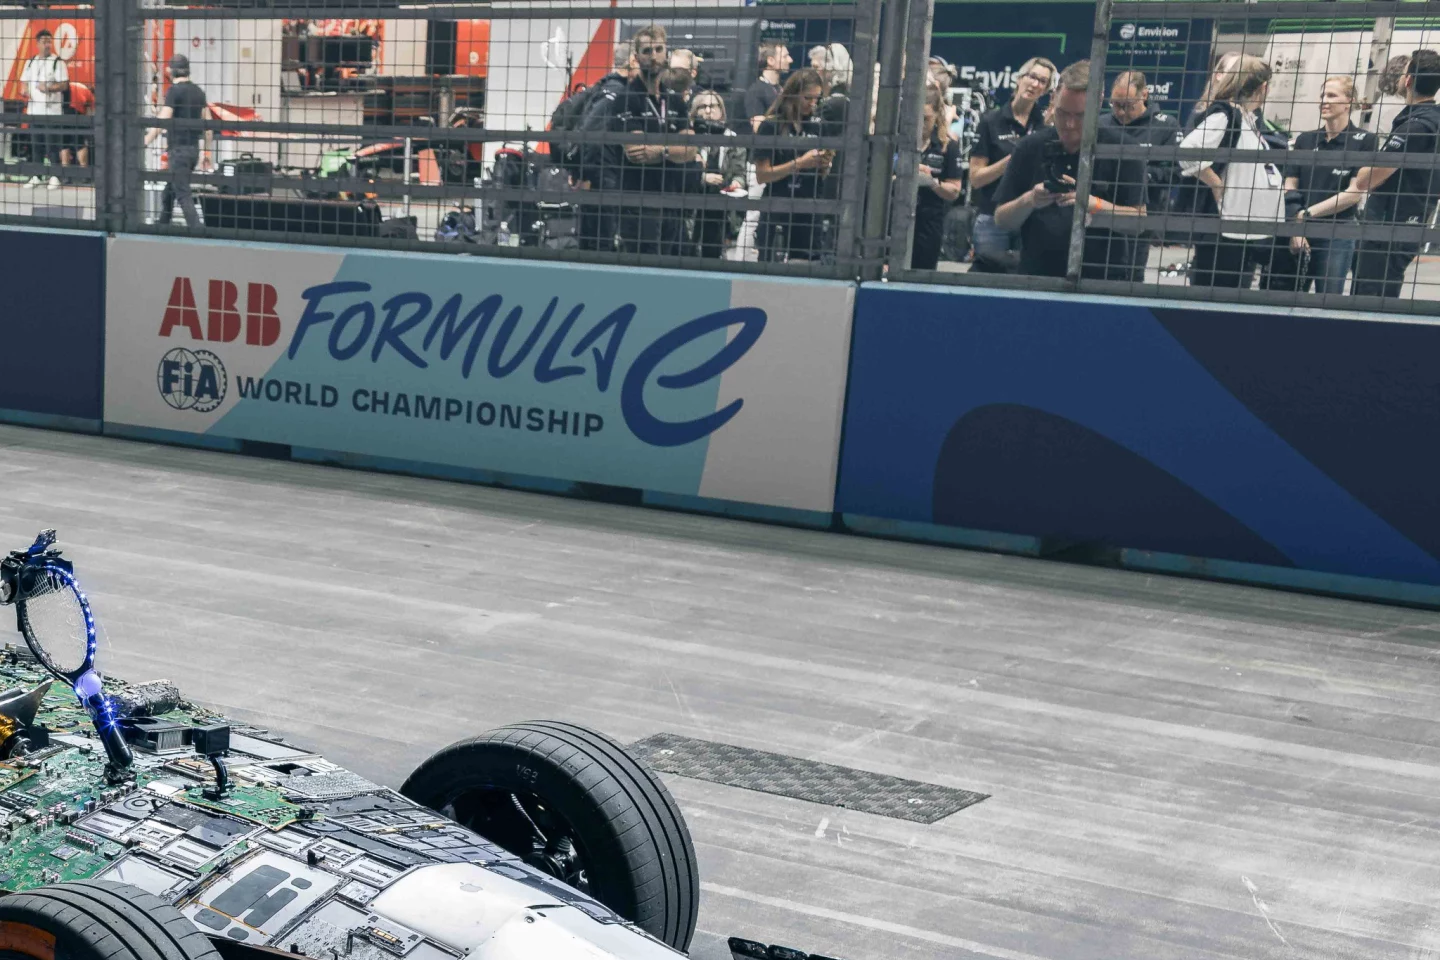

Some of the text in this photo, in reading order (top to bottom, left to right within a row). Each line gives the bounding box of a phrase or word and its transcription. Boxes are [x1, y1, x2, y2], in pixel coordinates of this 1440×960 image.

[158, 276, 282, 348] ABB
[287, 280, 638, 393] FORMULA
[235, 375, 605, 438] WORLD CHAMPIONSHIP
